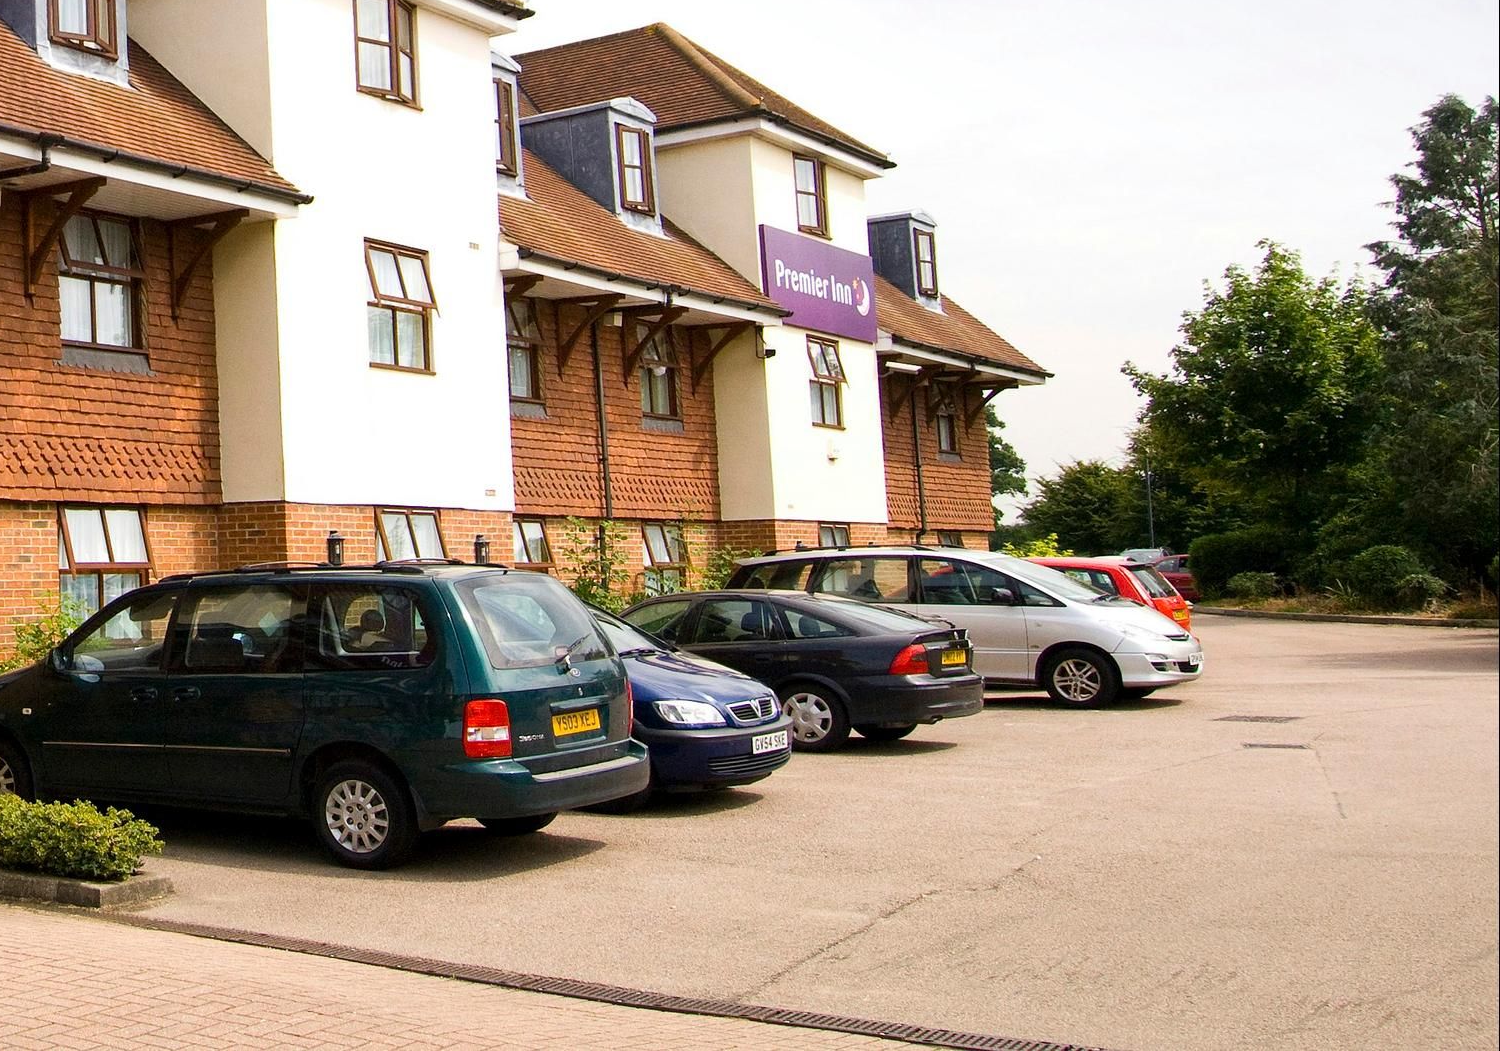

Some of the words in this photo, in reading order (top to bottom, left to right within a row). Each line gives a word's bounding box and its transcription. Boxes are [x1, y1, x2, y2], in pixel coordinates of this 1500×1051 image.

[775, 259, 829, 299] Premier
[831, 275, 853, 306] Inn
[556, 714, 579, 731] YS03
